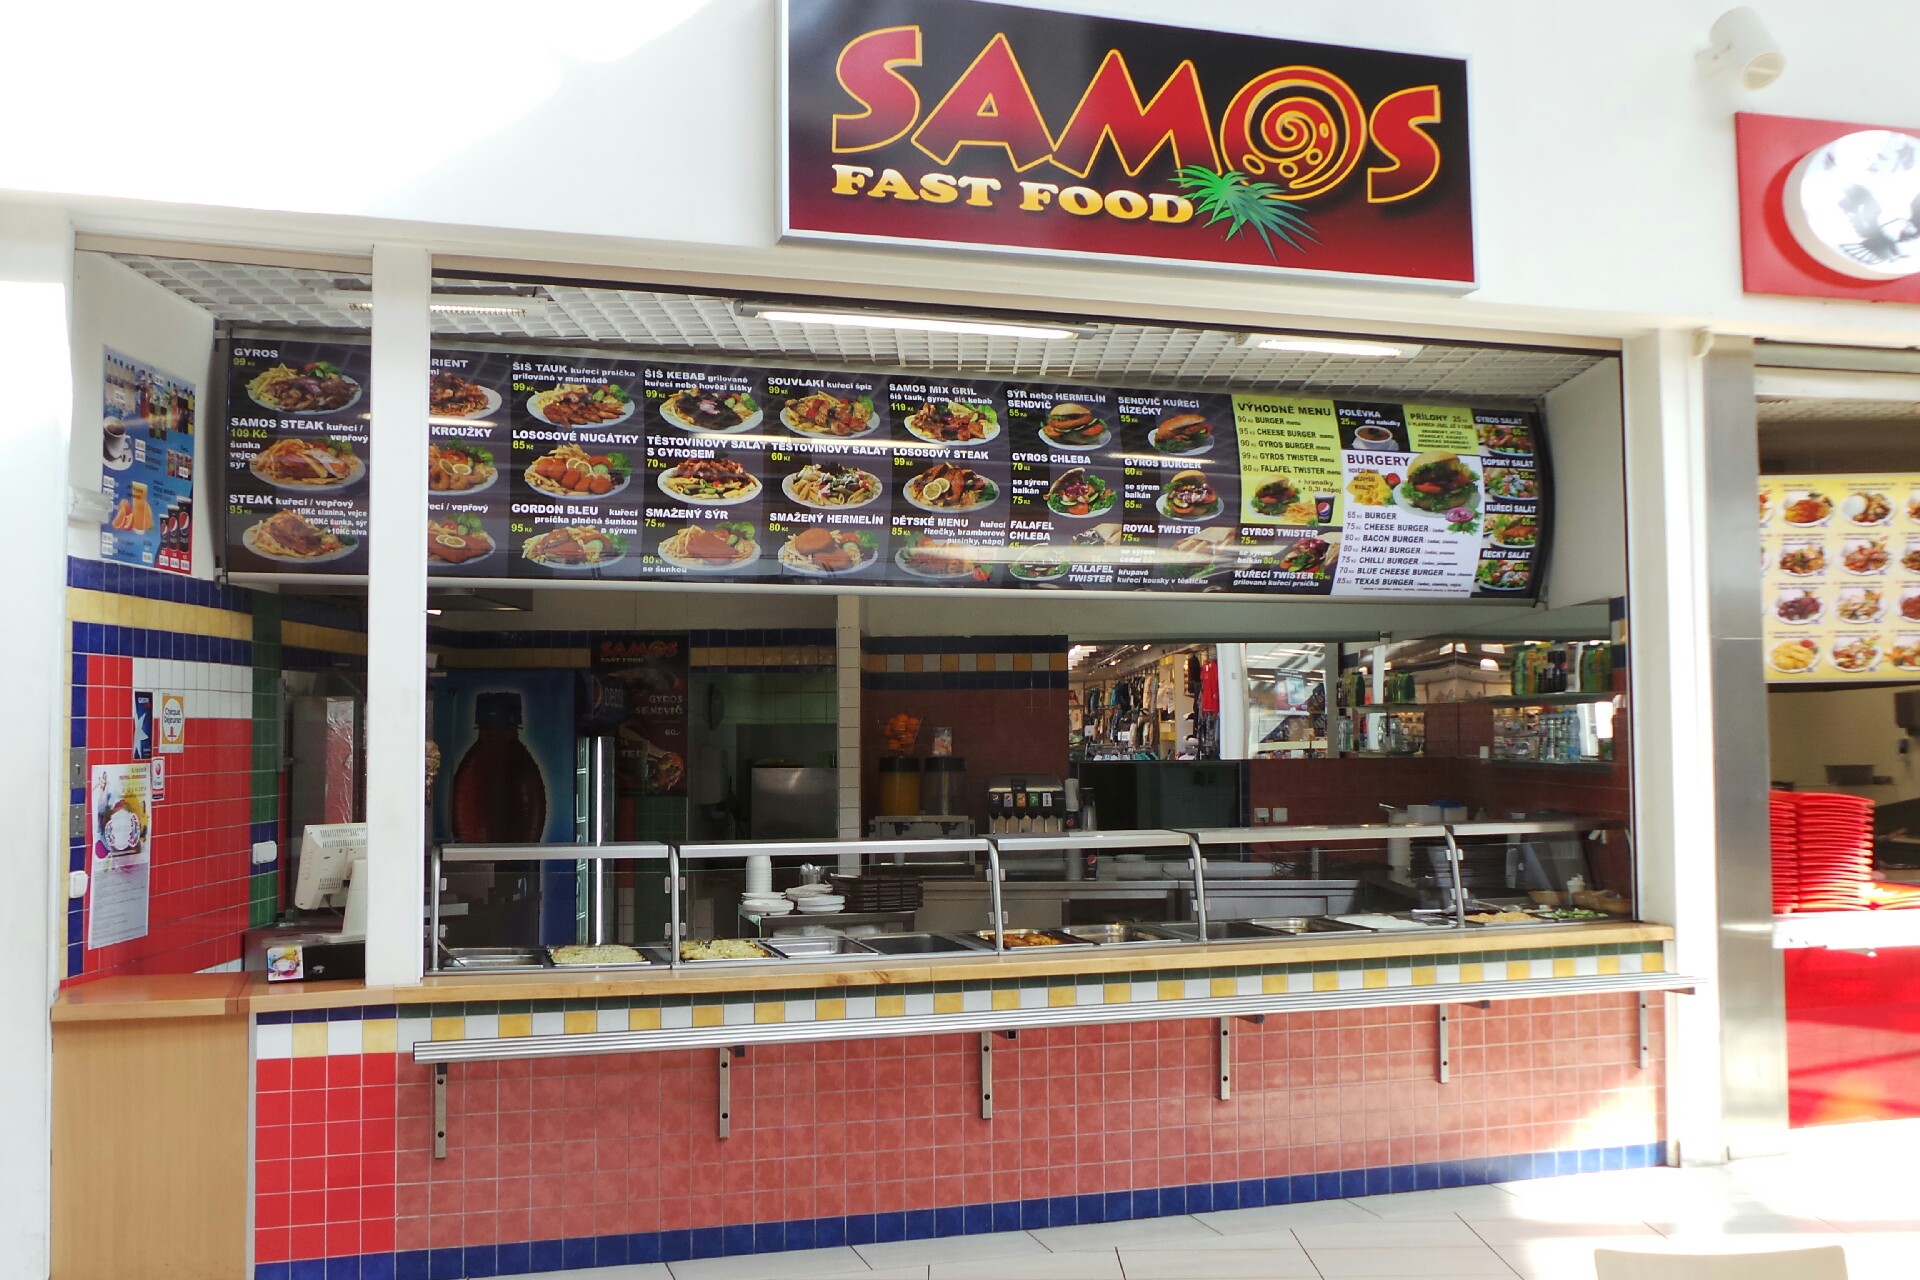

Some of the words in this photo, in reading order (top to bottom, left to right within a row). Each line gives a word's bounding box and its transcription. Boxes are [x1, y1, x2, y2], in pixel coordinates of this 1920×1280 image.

[831, 24, 1442, 204] SAMOS
[830, 163, 1001, 207] FAST
[1018, 180, 1194, 224] FOOD
[234, 348, 278, 358] GYROS
[233, 358, 246, 366] 99
[430, 359, 468, 368] RIENT
[512, 362, 532, 371] ŠIŠ
[535, 364, 567, 373] TAUK
[645, 369, 663, 378] ŠIŠ
[666, 371, 705, 381] KEBAB
[768, 377, 824, 387] SOUVLAKI
[513, 383, 525, 391] 99
[769, 386, 780, 394] 99
[889, 384, 926, 393] SAMOS
[930, 386, 949, 394] MIX
[953, 387, 977, 395] GRIL
[646, 390, 657, 398] 99
[904, 394, 925, 403] tauk,
[1007, 389, 1027, 399] SÝR
[1030, 392, 1053, 400] nebo
[1055, 393, 1106, 403] HERMELÍN
[1008, 400, 1051, 409] SENDVIČ
[1118, 395, 1160, 406] SENDVIČ
[1163, 398, 1199, 408] KUŘECÍ
[891, 403, 906, 411] 119
[1119, 405, 1162, 415] ŘÍZEČKY
[1238, 402, 1294, 414] VÝHODNÉ
[1299, 407, 1331, 416] MENU
[1009, 409, 1019, 417] 55
[231, 417, 277, 428] SAMOS
[280, 420, 323, 430] STEAK
[1255, 417, 1284, 425] BURGER
[231, 429, 250, 438] 109
[252, 429, 268, 438] Kč
[432, 426, 492, 437] KROUŽKY
[1287, 430, 1316, 438] BURGER
[330, 433, 368, 444] vepřový
[512, 429, 577, 441] LOSOSOVÉ
[580, 432, 638, 444] NUGÁTKY
[230, 441, 260, 449] šunka
[513, 441, 525, 449] 85
[1285, 442, 1314, 450] BURGER
[230, 452, 257, 460] vejce
[647, 448, 654, 456] S
[658, 448, 715, 458] GYROSEM
[772, 453, 782, 461] 60
[894, 447, 950, 458] LOSOSOVÝ
[954, 450, 989, 460] STEAK
[894, 458, 905, 466] 99
[1012, 453, 1048, 462] GYROS
[1050, 455, 1091, 464] CHLEBA
[1287, 454, 1318, 462] TWISTER
[1347, 454, 1410, 466] BURGERY
[230, 460, 245, 469] sýr
[647, 459, 658, 467] 70
[1125, 458, 1159, 467] GYROS
[1161, 460, 1201, 469] BURGER
[1261, 465, 1291, 473] FALAFEL
[1294, 466, 1325, 474] TWISTER
[1025, 478, 1048, 487] sýrem
[1137, 483, 1159, 492] sýrem
[229, 495, 273, 505] STEAK
[315, 499, 353, 508] vepřový
[1013, 496, 1023, 504] 75
[229, 506, 243, 514] 95
[512, 504, 564, 514] GORDON
[567, 505, 598, 515] BLEU
[645, 508, 702, 518] SMAŽENÝ
[705, 508, 728, 519] SÝR
[770, 513, 823, 523] SMAŽENÝ
[827, 514, 883, 524] HERMELÍN
[1365, 512, 1396, 520] BURGER
[645, 518, 656, 527] 75
[892, 516, 934, 526] DĚTSKÉ
[938, 518, 968, 527] MENU
[1010, 521, 1054, 530] FALAFEL
[511, 524, 523, 532] 95
[609, 526, 637, 535] sýrem
[769, 523, 780, 531] 80
[892, 527, 903, 535] 85
[1123, 524, 1155, 533] ROYAL
[1158, 525, 1201, 534] TWISTER
[1364, 523, 1394, 531] CHEESE
[1009, 531, 1051, 540] CHLEBA
[1242, 528, 1274, 536] GYROS
[1277, 529, 1318, 538] TWISTER
[1363, 534, 1389, 542] BACON
[1391, 535, 1424, 543] BURGER
[1361, 545, 1387, 553] HAWAI
[1389, 547, 1421, 555] BURGER
[1072, 564, 1114, 573] FALAFEL
[1357, 567, 1377, 575] BLUE
[1068, 574, 1112, 583] TWISTER
[1235, 569, 1271, 578] KUŘECÍ
[1273, 571, 1314, 580] TWISTER
[1355, 578, 1380, 586] TEXAS
[601, 640, 678, 657] SAMOS
[650, 695, 684, 703] GYROS
